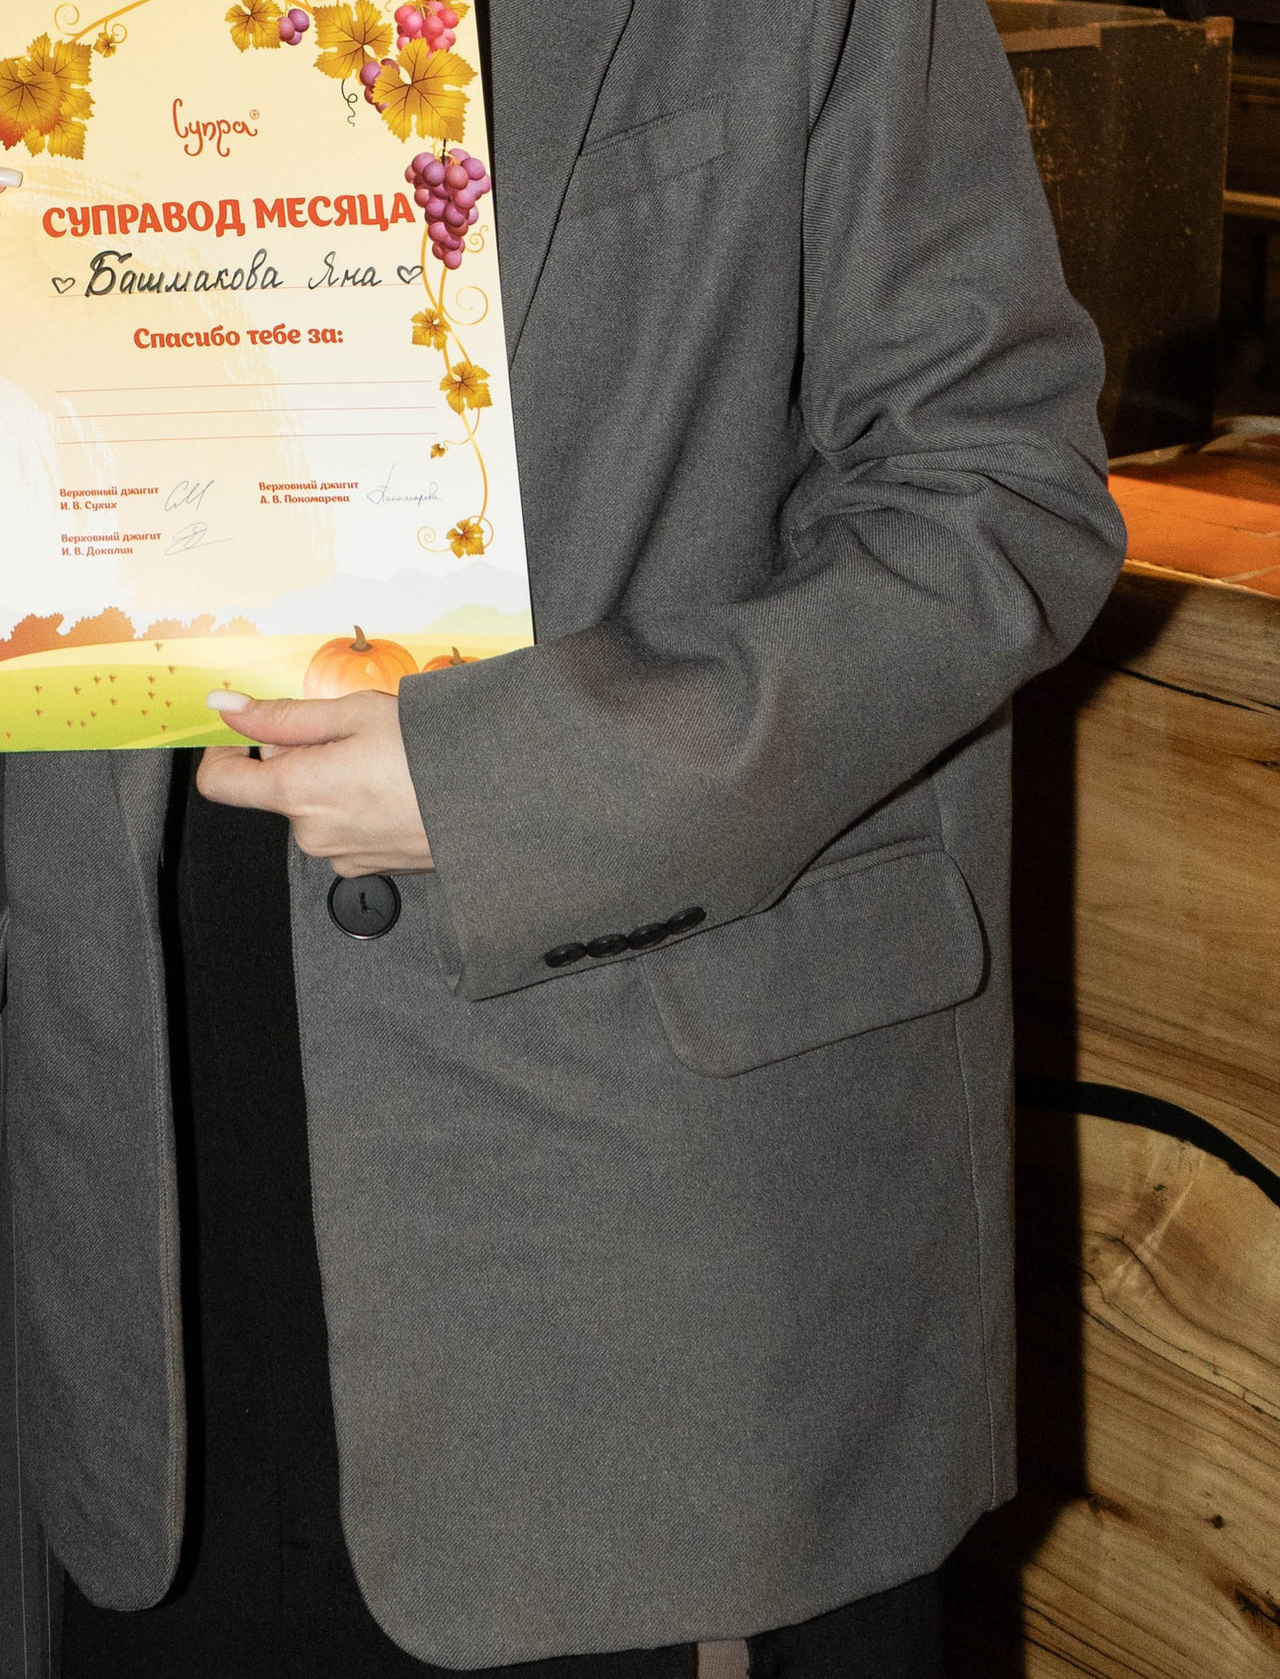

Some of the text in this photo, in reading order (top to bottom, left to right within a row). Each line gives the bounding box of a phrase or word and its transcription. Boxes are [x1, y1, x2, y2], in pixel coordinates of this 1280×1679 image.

[41, 191, 417, 239] СУПРАВОД МЕСЯЦА
[84, 248, 383, 298] Башмакова Яна
[133, 323, 344, 349] Спасибо тебе за:
[59, 485, 160, 499] Верховный джигит
[258, 479, 359, 493] Верховный джигит
[60, 500, 118, 512] И. В. Сухих
[259, 493, 350, 505] А. В. Пономарева
[61, 532, 162, 545] Верховный джигит
[86, 545, 134, 558] Докалин
